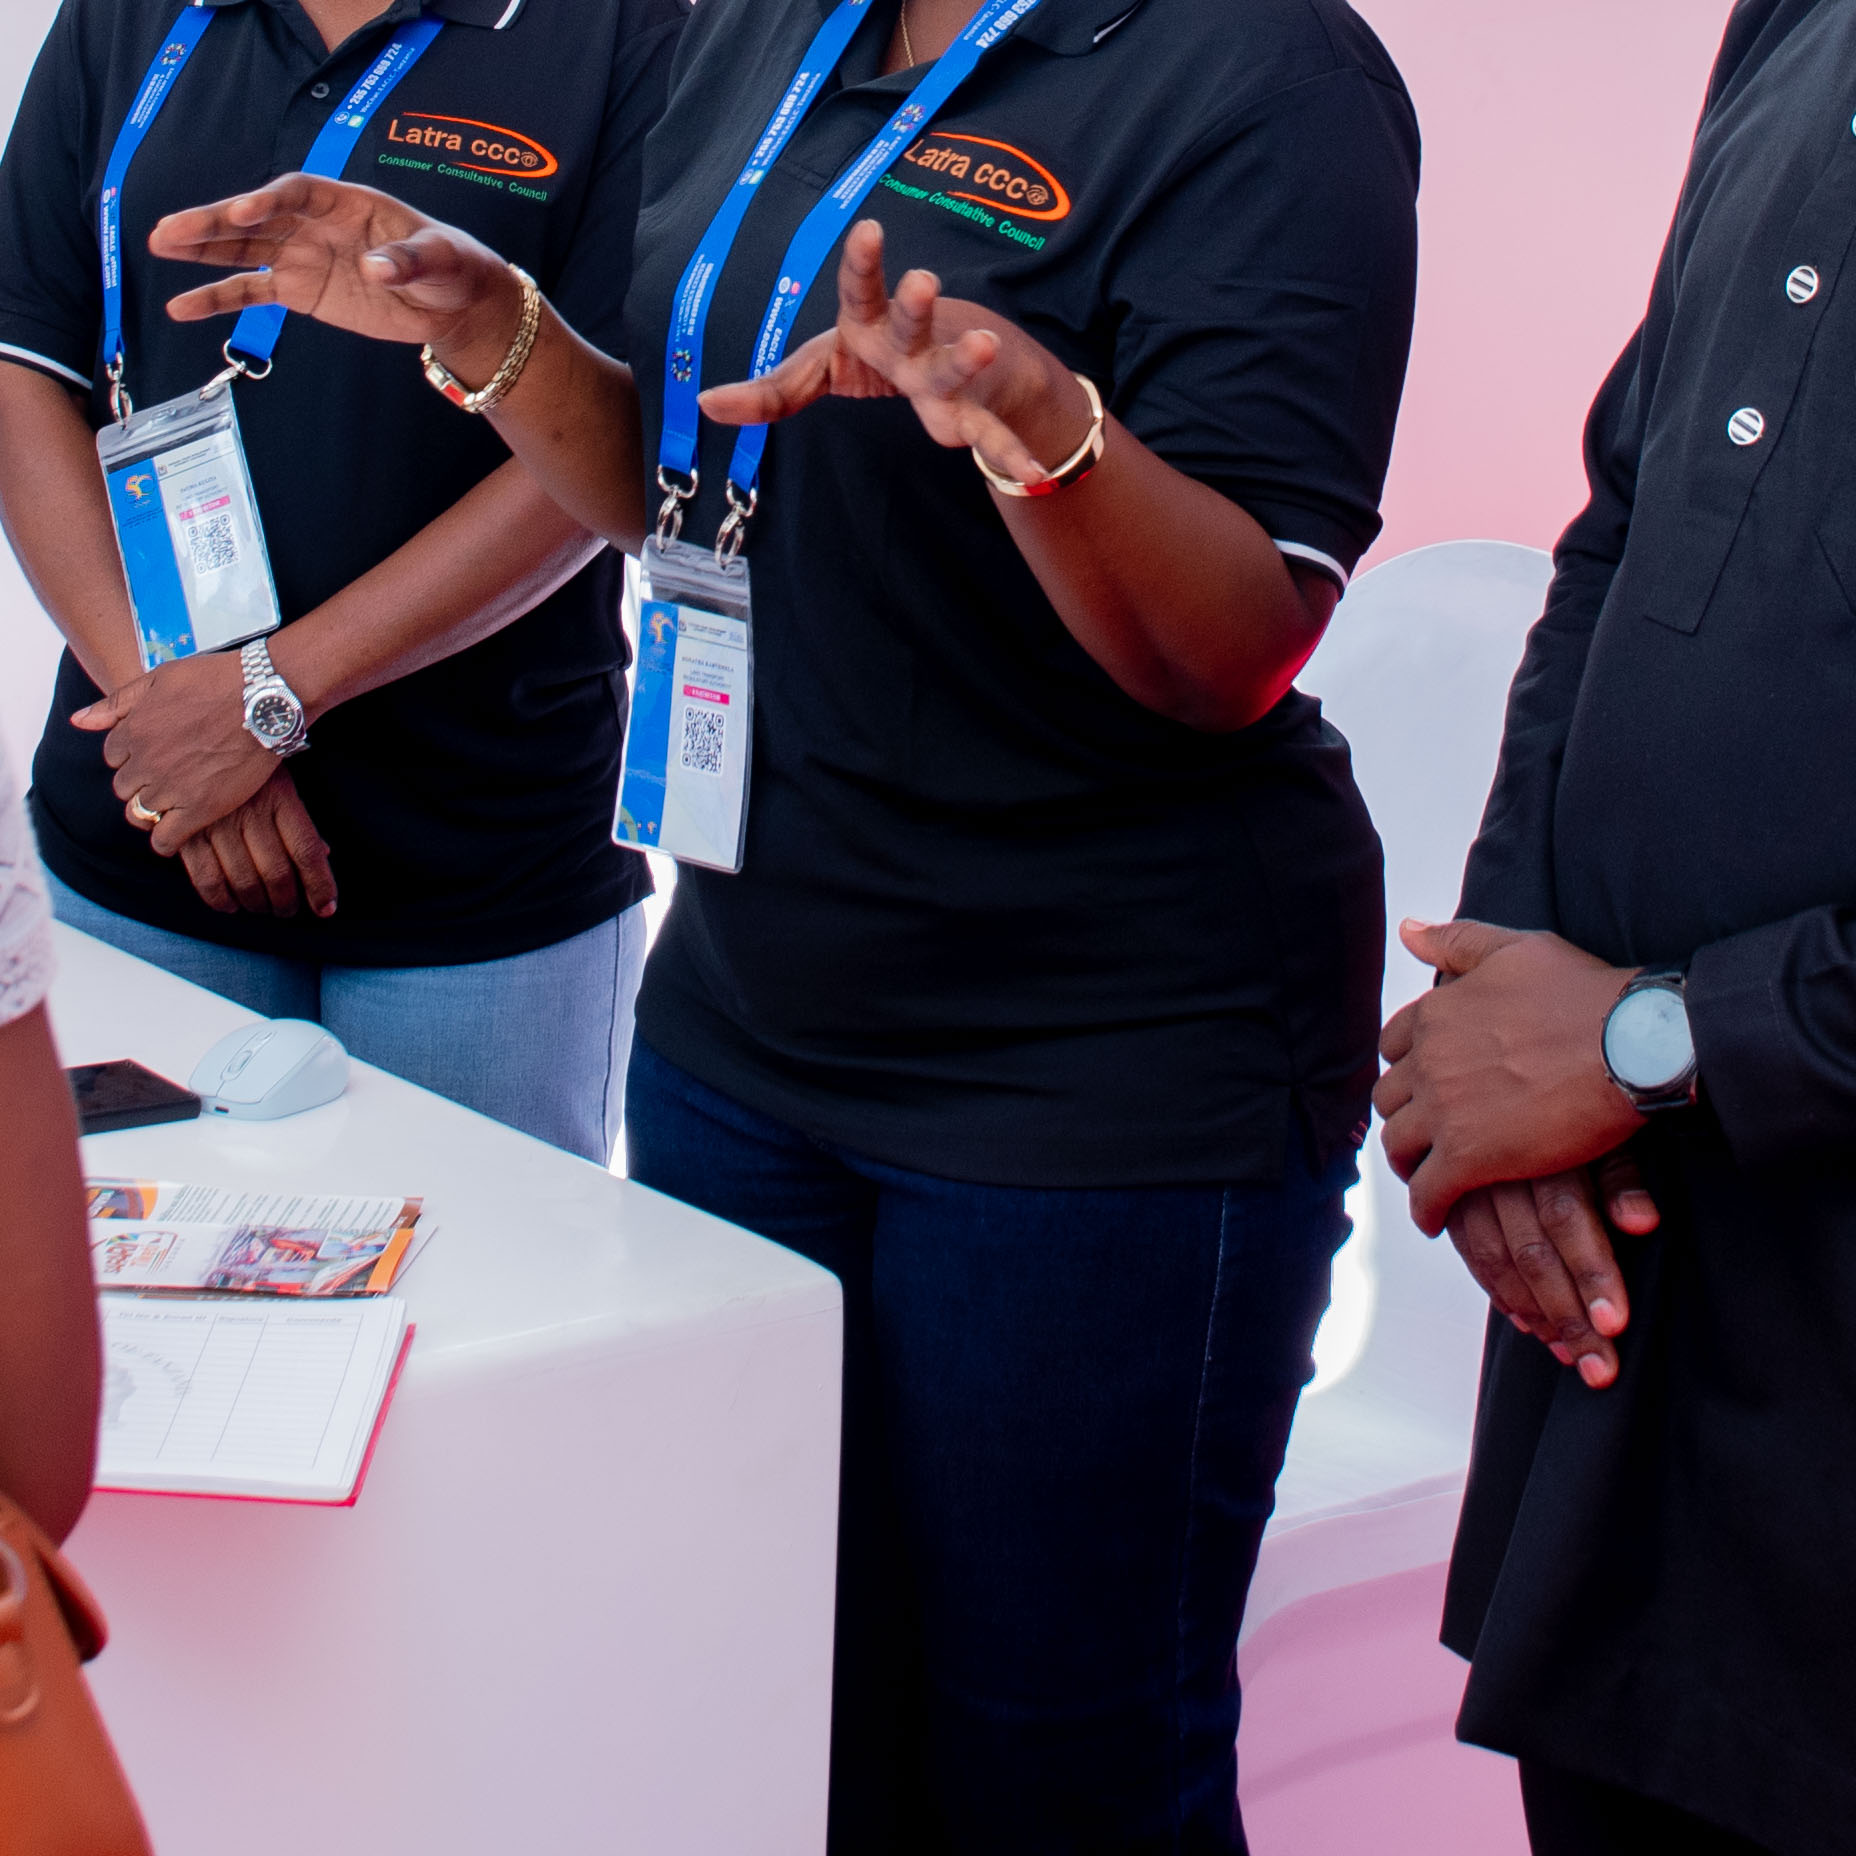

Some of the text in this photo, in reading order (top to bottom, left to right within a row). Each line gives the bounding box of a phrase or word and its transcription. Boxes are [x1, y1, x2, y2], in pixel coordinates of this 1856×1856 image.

[387, 118, 463, 152] Latra
[378, 153, 548, 202] Consumer Consultative Council
[902, 138, 972, 179] Latra
[878, 173, 929, 200] Consumer
[928, 191, 996, 229] Consultative
[998, 220, 1046, 252] Council
